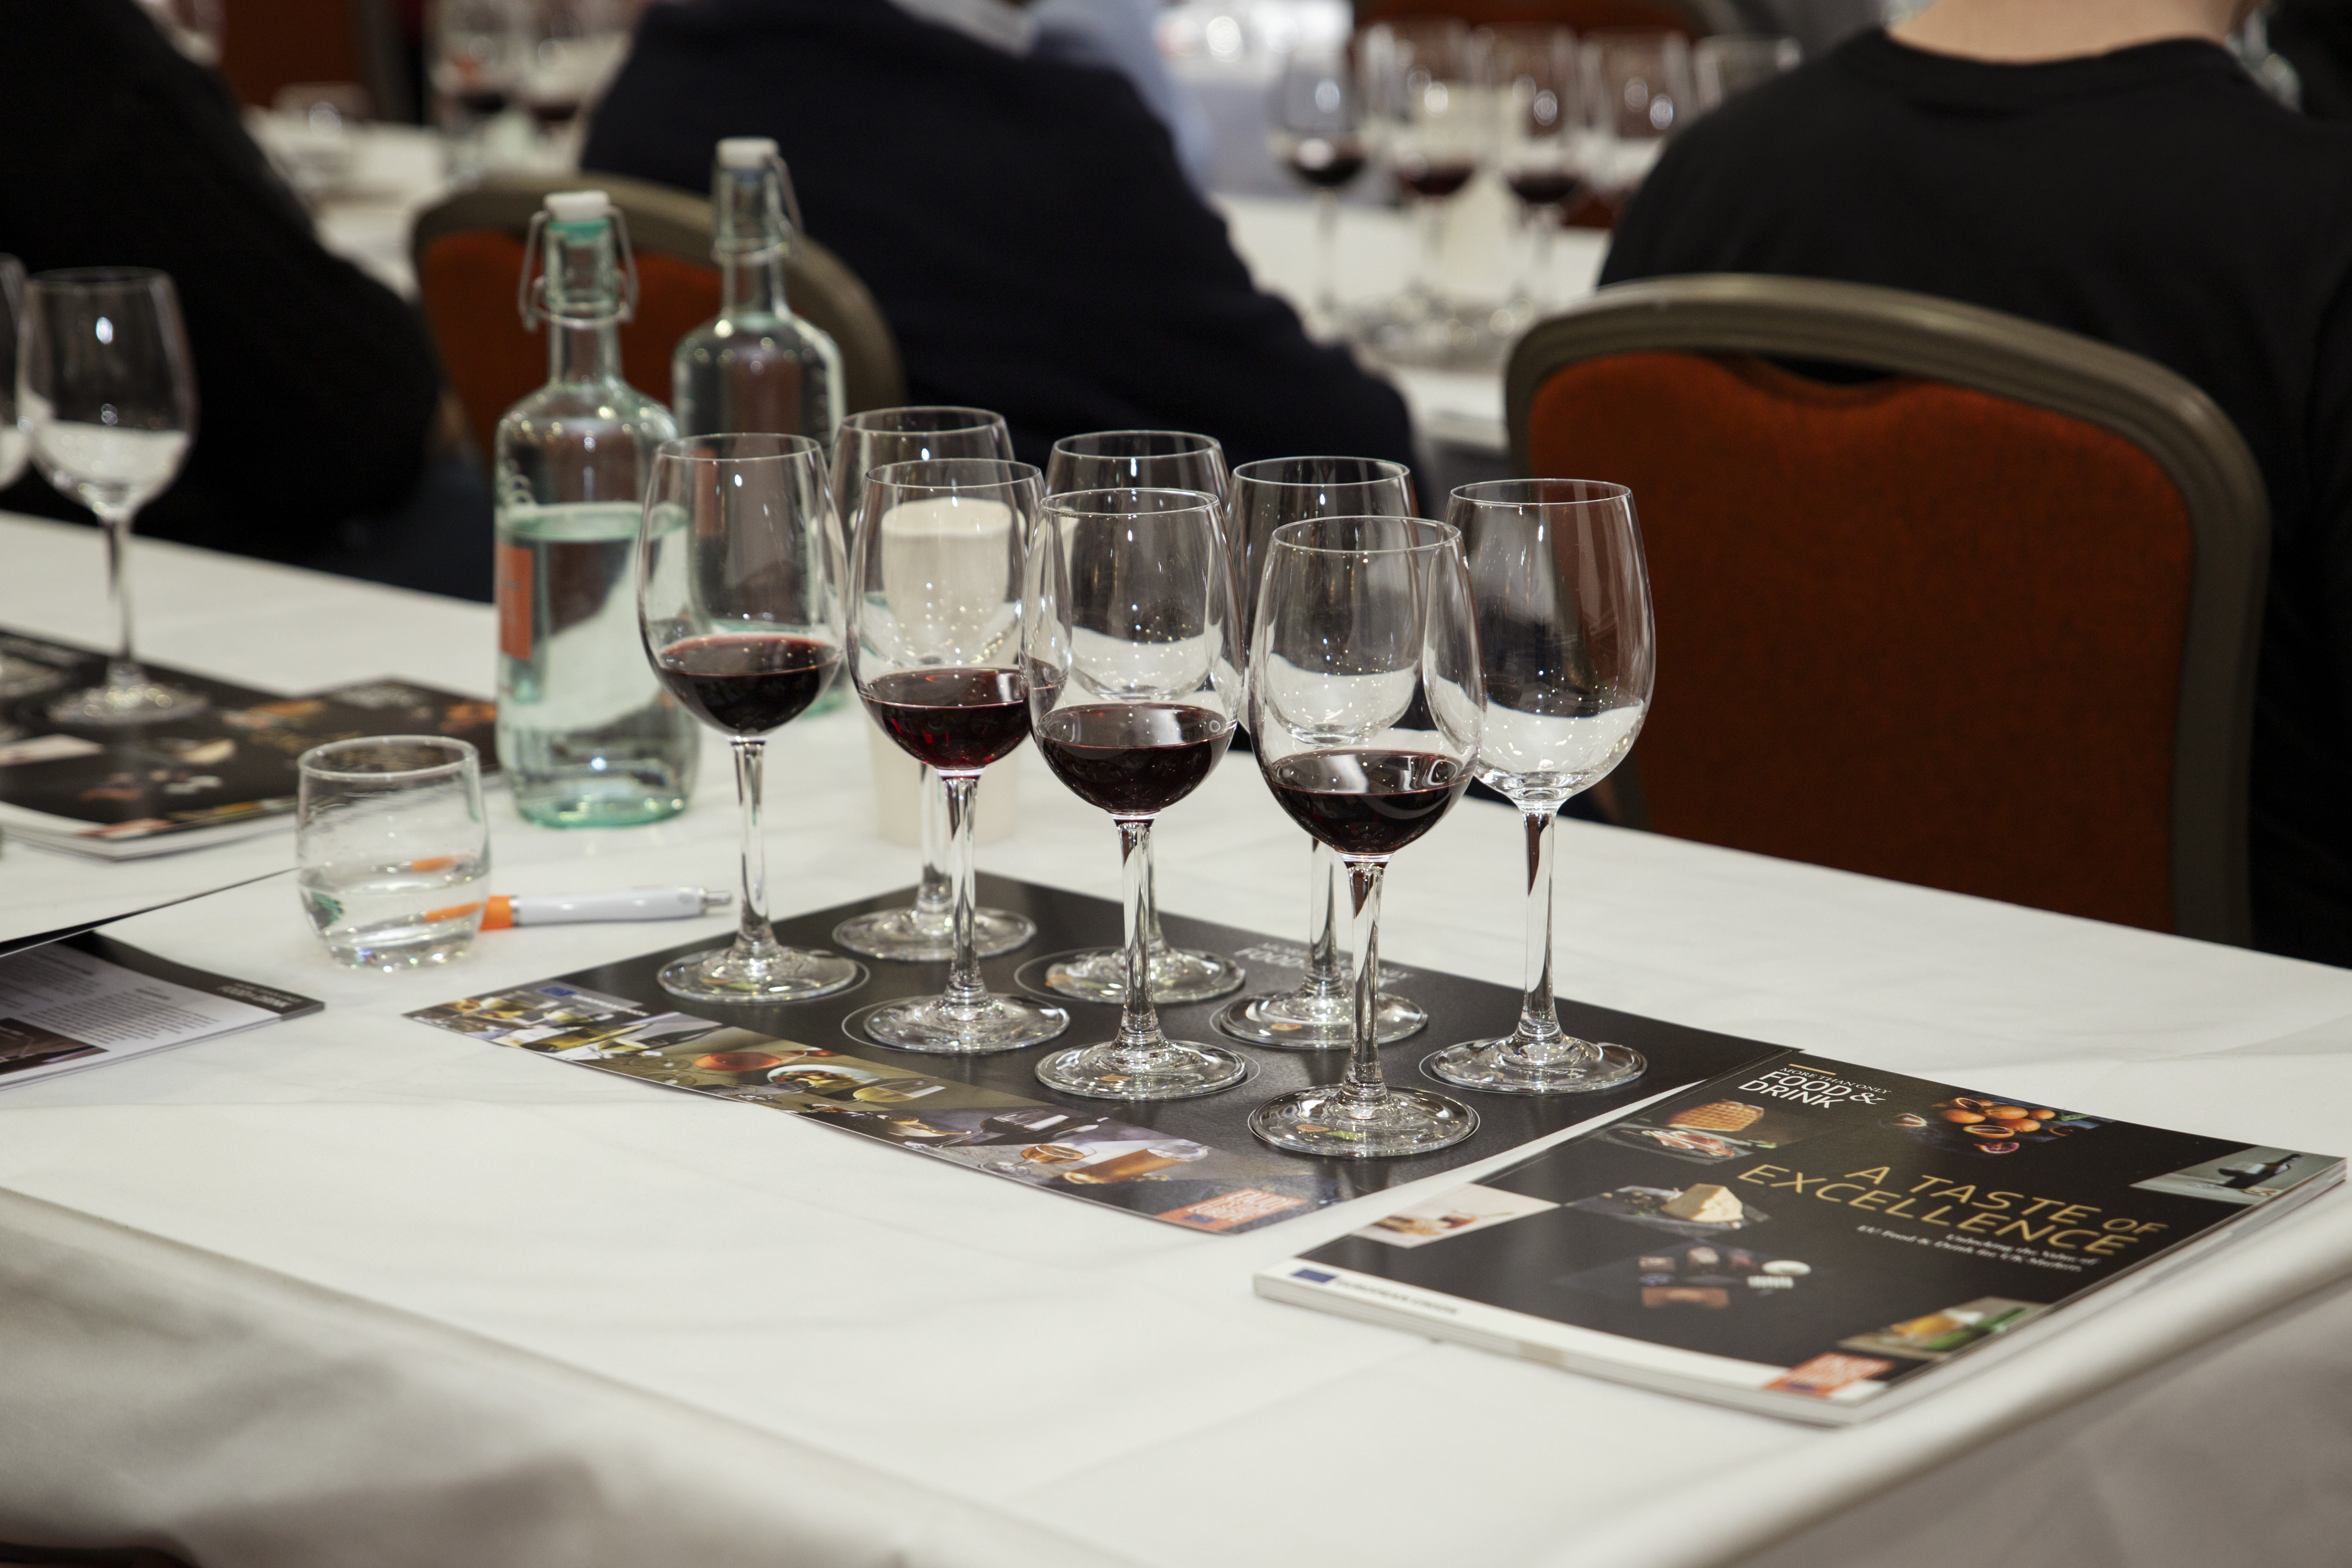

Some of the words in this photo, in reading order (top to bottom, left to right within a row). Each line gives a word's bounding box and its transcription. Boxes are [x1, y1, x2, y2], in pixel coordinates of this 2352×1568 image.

[1738, 1080, 1845, 1108] DRINK
[1758, 1071, 1852, 1096] FOOD
[1849, 1092, 1886, 1104] &
[1780, 1067, 1817, 1078] MORE
[1819, 1075, 1855, 1086] THAN
[1856, 1084, 1892, 1094] ONLY
[1737, 1164, 2139, 1256] EXCELLENCE
[1843, 1166, 1891, 1185] A
[1910, 1175, 2102, 1225] TASTE
[2102, 1218, 2169, 1236] OF
